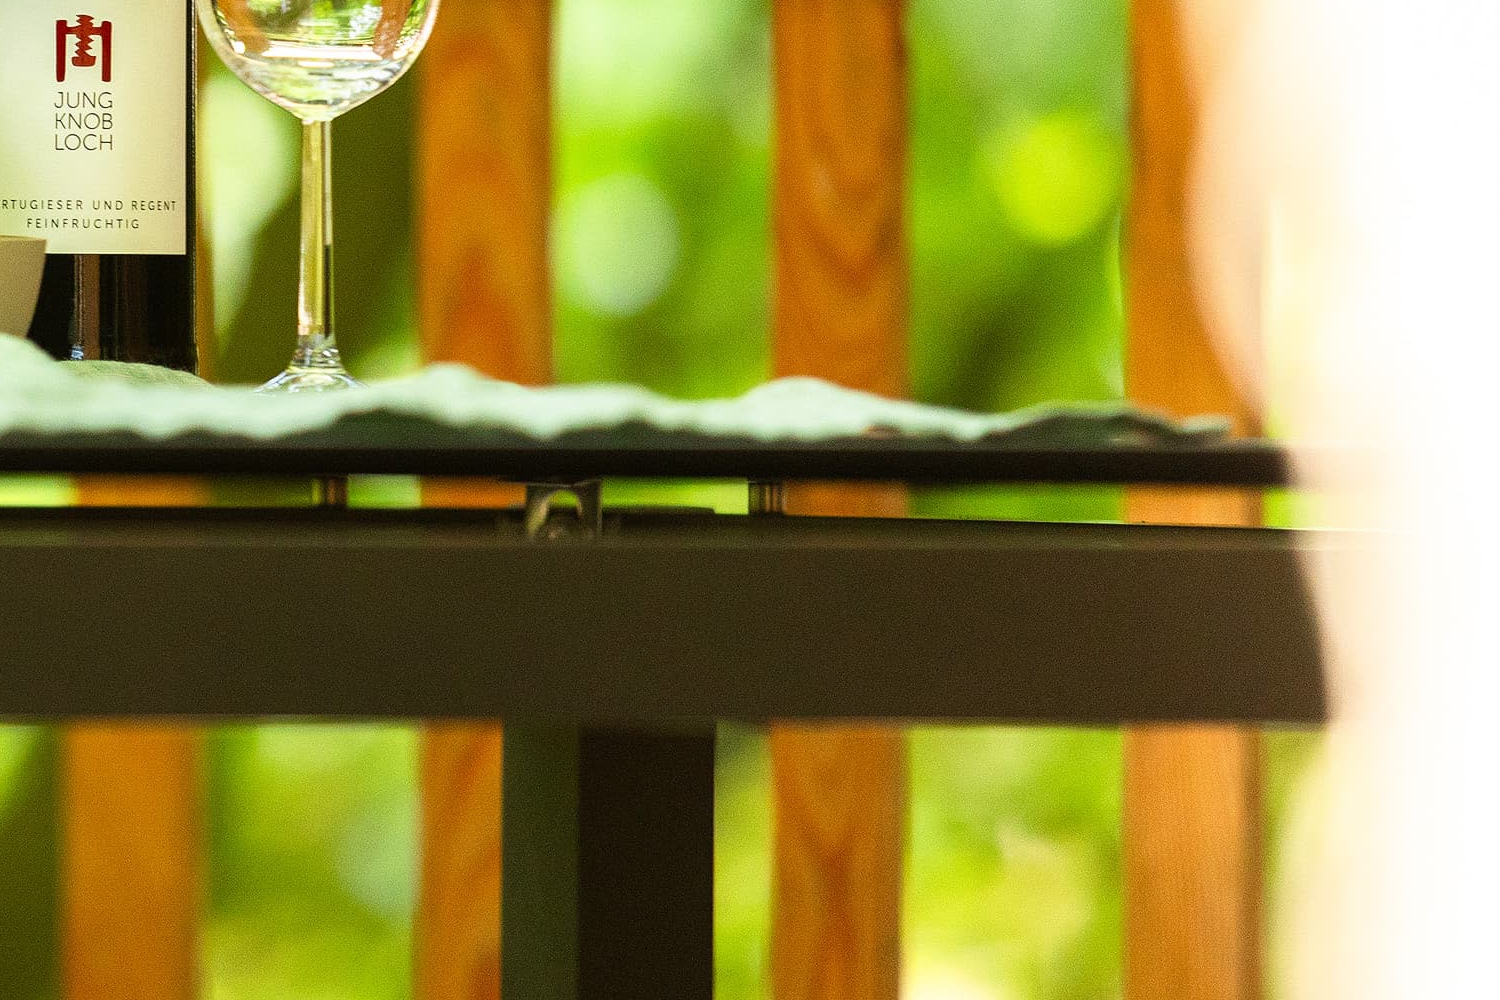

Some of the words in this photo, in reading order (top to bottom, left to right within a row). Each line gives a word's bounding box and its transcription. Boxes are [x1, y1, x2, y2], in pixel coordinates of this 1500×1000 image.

[54, 91, 113, 109] JUNG
[54, 112, 113, 130] KNOB
[54, 133, 113, 151] LOCH
[92, 200, 124, 211] UND
[131, 200, 176, 212] REGENT
[27, 218, 140, 230] FEINFRUCHTIG
